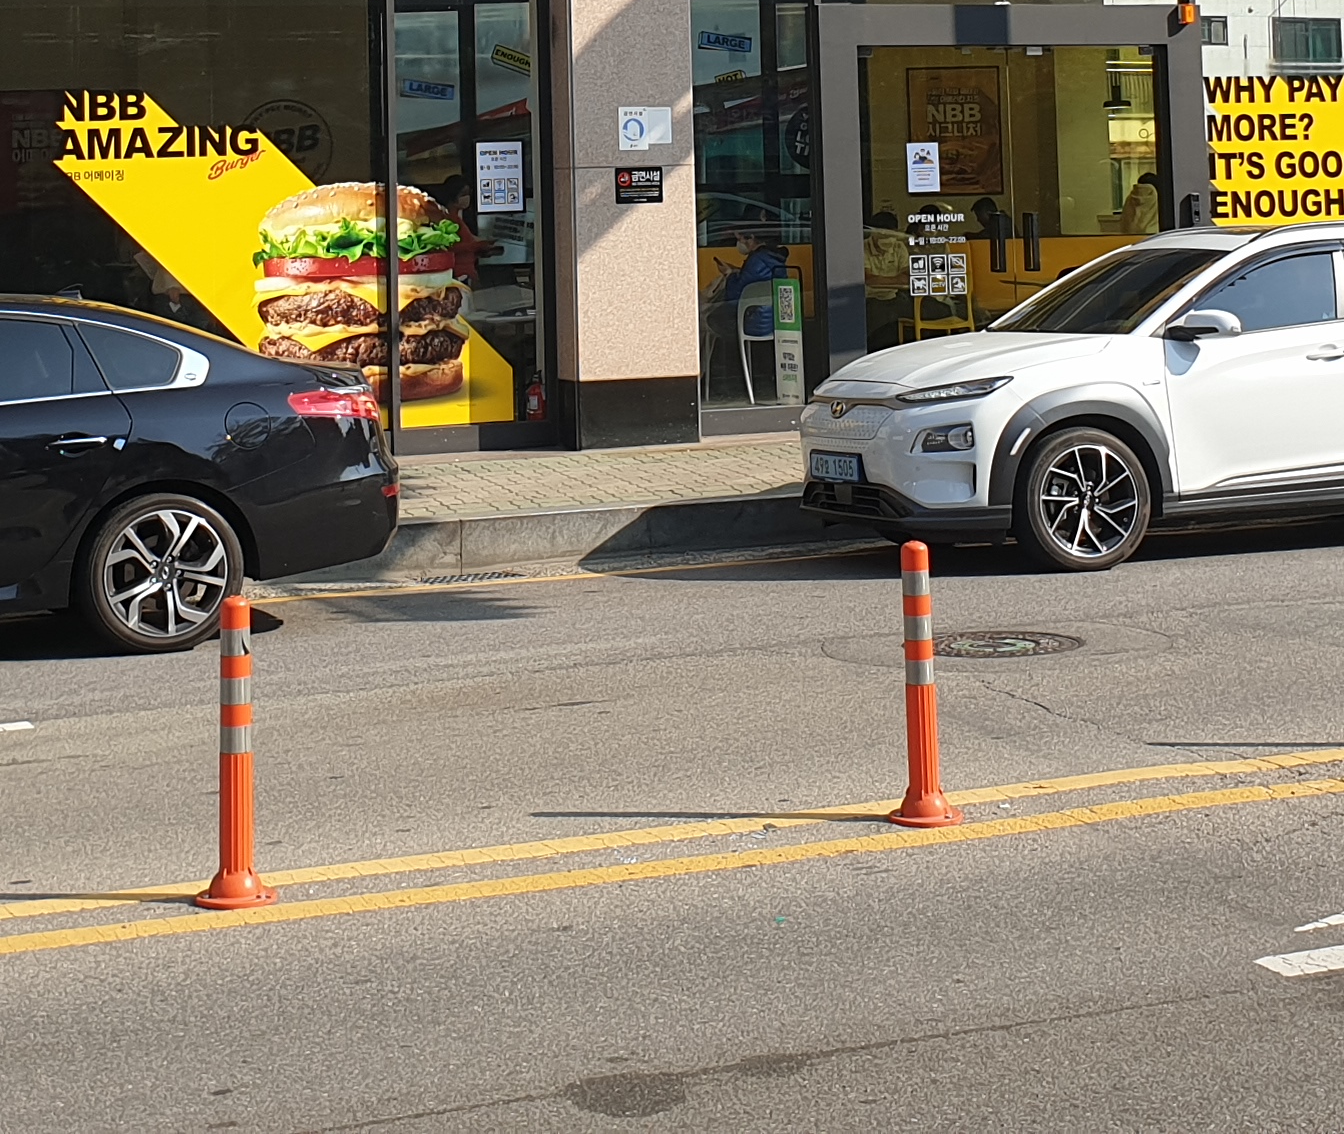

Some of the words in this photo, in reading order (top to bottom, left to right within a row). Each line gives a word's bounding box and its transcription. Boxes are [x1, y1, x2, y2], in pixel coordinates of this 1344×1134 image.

[707, 34, 746, 50] LARGE
[409, 82, 448, 97] LARGE
[1202, 75, 1279, 104] WHY
[1286, 74, 1344, 103] PAY
[58, 88, 147, 122] NBB
[926, 103, 982, 122] NBB
[927, 123, 981, 137] 시그니처
[1206, 113, 1314, 142] MORE?
[58, 125, 260, 161] AMAZING
[207, 149, 267, 180] Burger
[1208, 151, 1266, 180] IT'S
[83, 170, 125, 182] 어메이징
[631, 170, 660, 182] 금연시설
[908, 214, 934, 223] OPEN
[937, 213, 965, 222] HOUR
